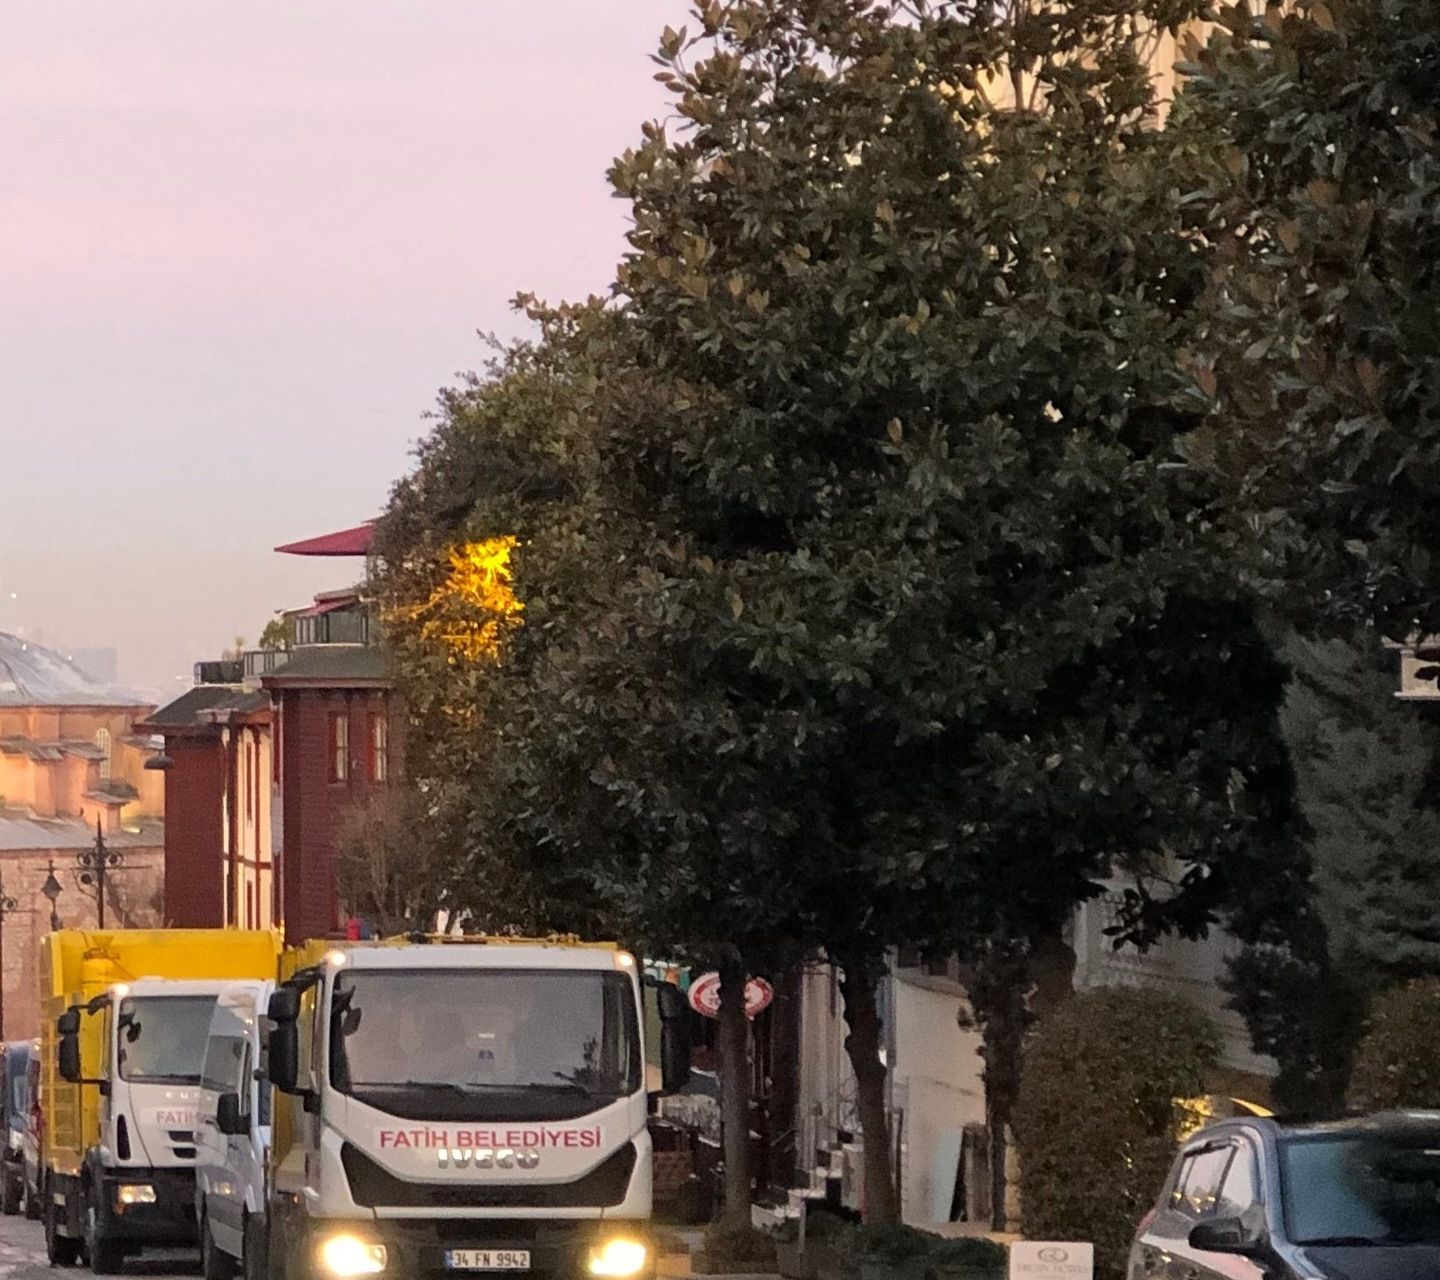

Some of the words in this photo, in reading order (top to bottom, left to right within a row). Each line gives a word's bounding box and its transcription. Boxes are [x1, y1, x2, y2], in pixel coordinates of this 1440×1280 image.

[380, 1126, 448, 1148] FATİH
[456, 1126, 602, 1148] BELEDİYESİ
[438, 1148, 540, 1170] IVECO
[455, 1252, 469, 1267] 34
[475, 1252, 491, 1267] FN
[496, 1252, 528, 1267] 9942
